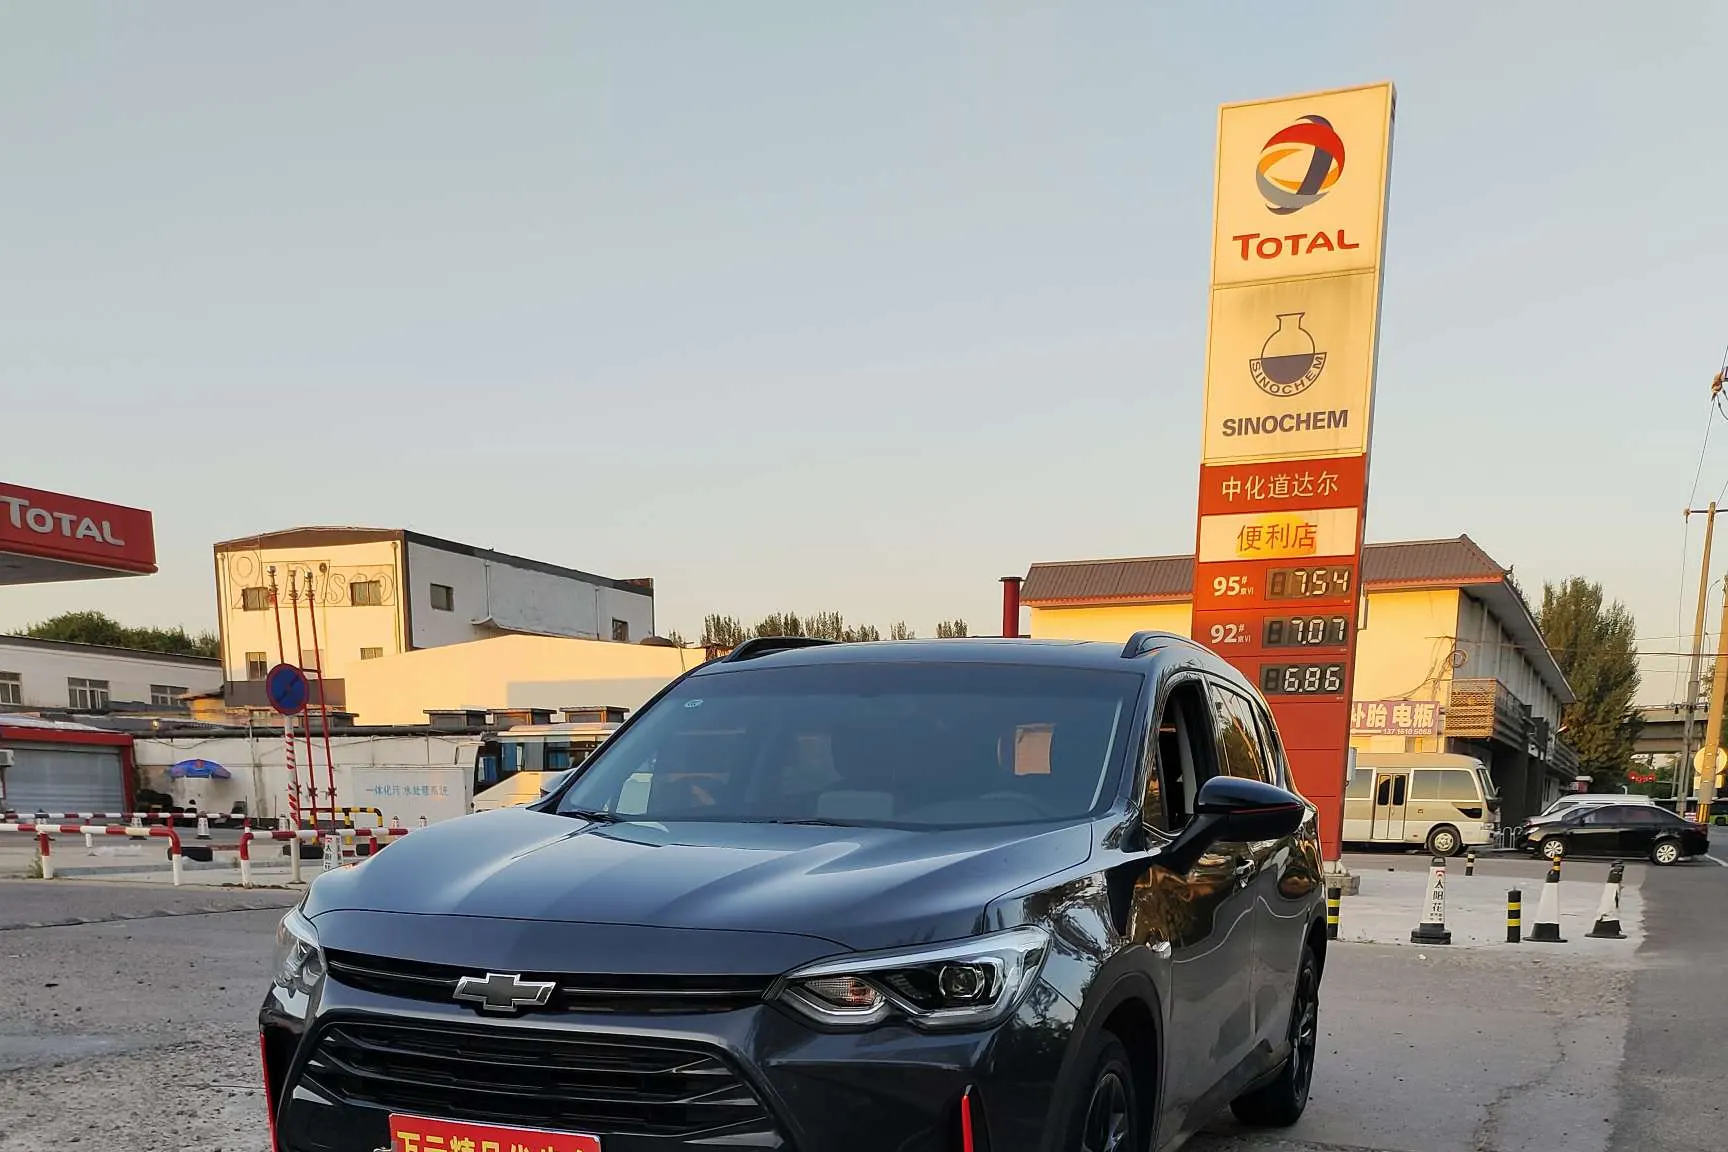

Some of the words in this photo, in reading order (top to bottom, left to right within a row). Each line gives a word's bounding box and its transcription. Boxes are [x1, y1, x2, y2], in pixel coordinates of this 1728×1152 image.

[1231, 229, 1360, 261] TOTAL
[1252, 355, 1324, 394] SINOCHEM
[1221, 409, 1349, 437] SINOCHEM
[1221, 471, 1339, 501] 中化道达尔
[0, 495, 125, 546] TOTAL
[1236, 522, 1318, 551] 便利店
[1294, 570, 1349, 597] 7.54
[1291, 617, 1345, 645] 7.07
[1284, 666, 1340, 693] 6.86
[1392, 703, 1434, 728] 电瓶
